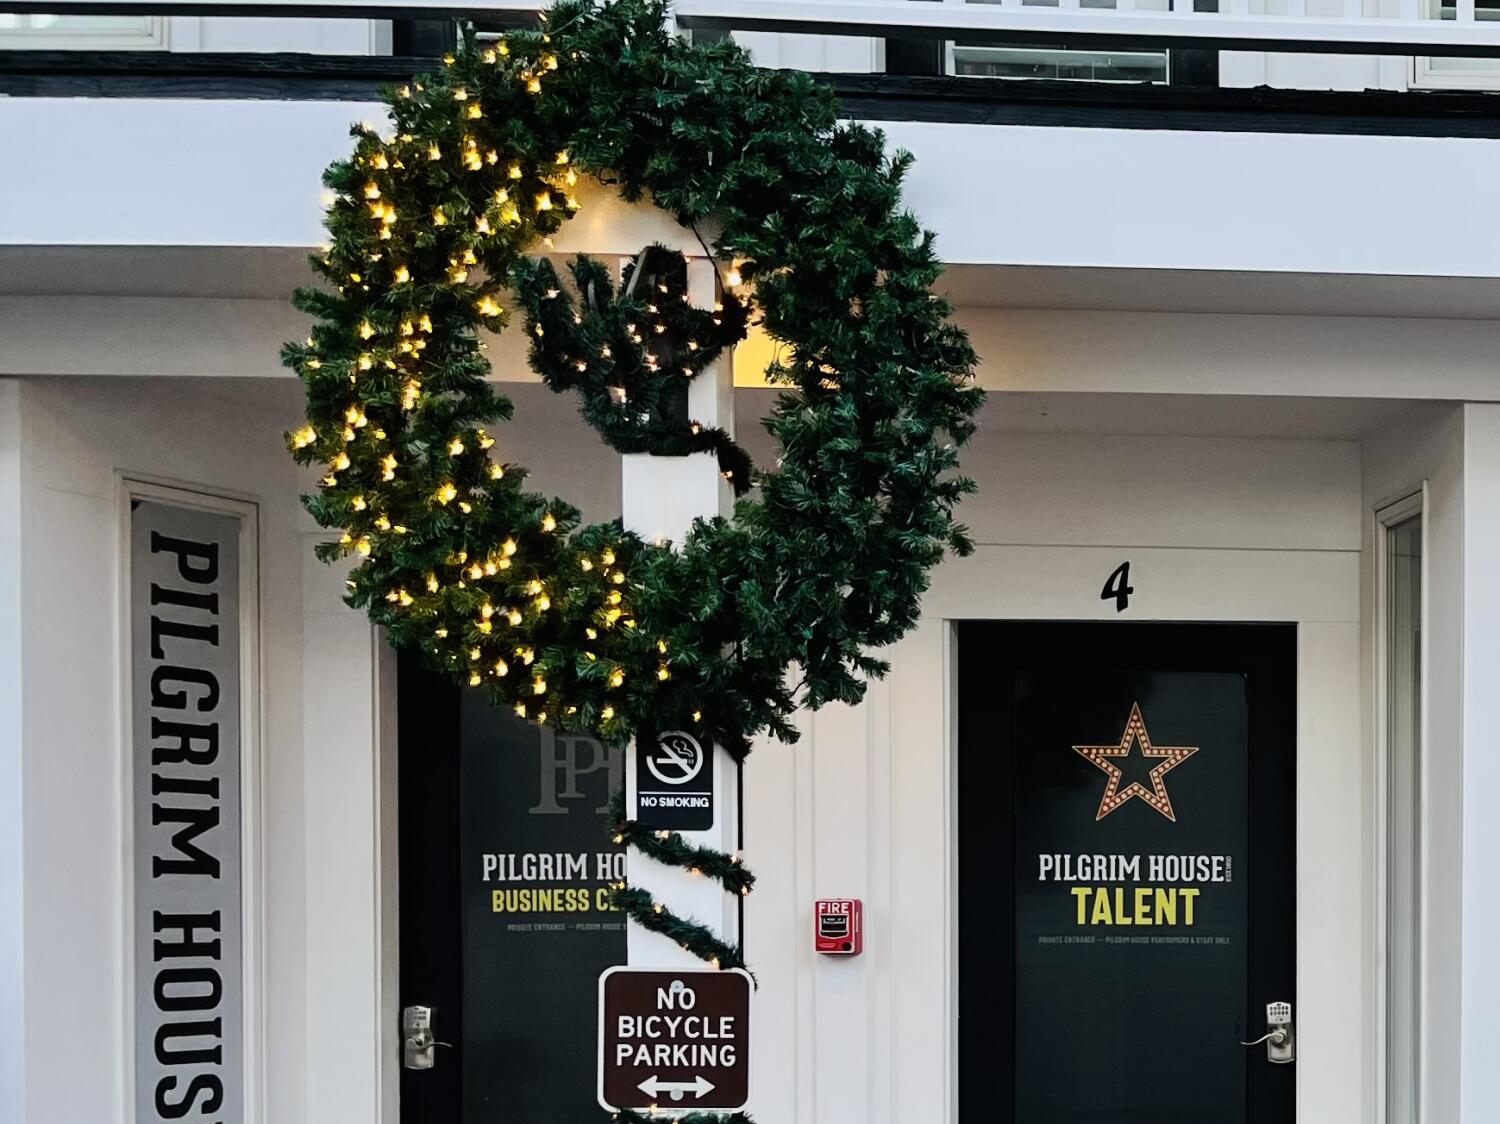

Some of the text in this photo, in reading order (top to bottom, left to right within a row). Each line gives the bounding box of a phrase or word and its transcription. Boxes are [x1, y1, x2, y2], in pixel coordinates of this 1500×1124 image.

[1100, 561, 1134, 613] 4
[150, 530, 220, 880] PILGRIM
[641, 797, 710, 808] NO SMOKING
[482, 852, 628, 881] PILGRIM HO
[1038, 853, 1141, 882] PILGRIM
[1148, 855, 1225, 882] HOUSE
[492, 888, 590, 913] BUSINESS
[818, 902, 850, 914] FIRE
[1071, 887, 1200, 926] TALENT
[657, 987, 696, 1010] NO
[618, 1015, 735, 1038] BICYCLE
[616, 1043, 736, 1067] PARKING
